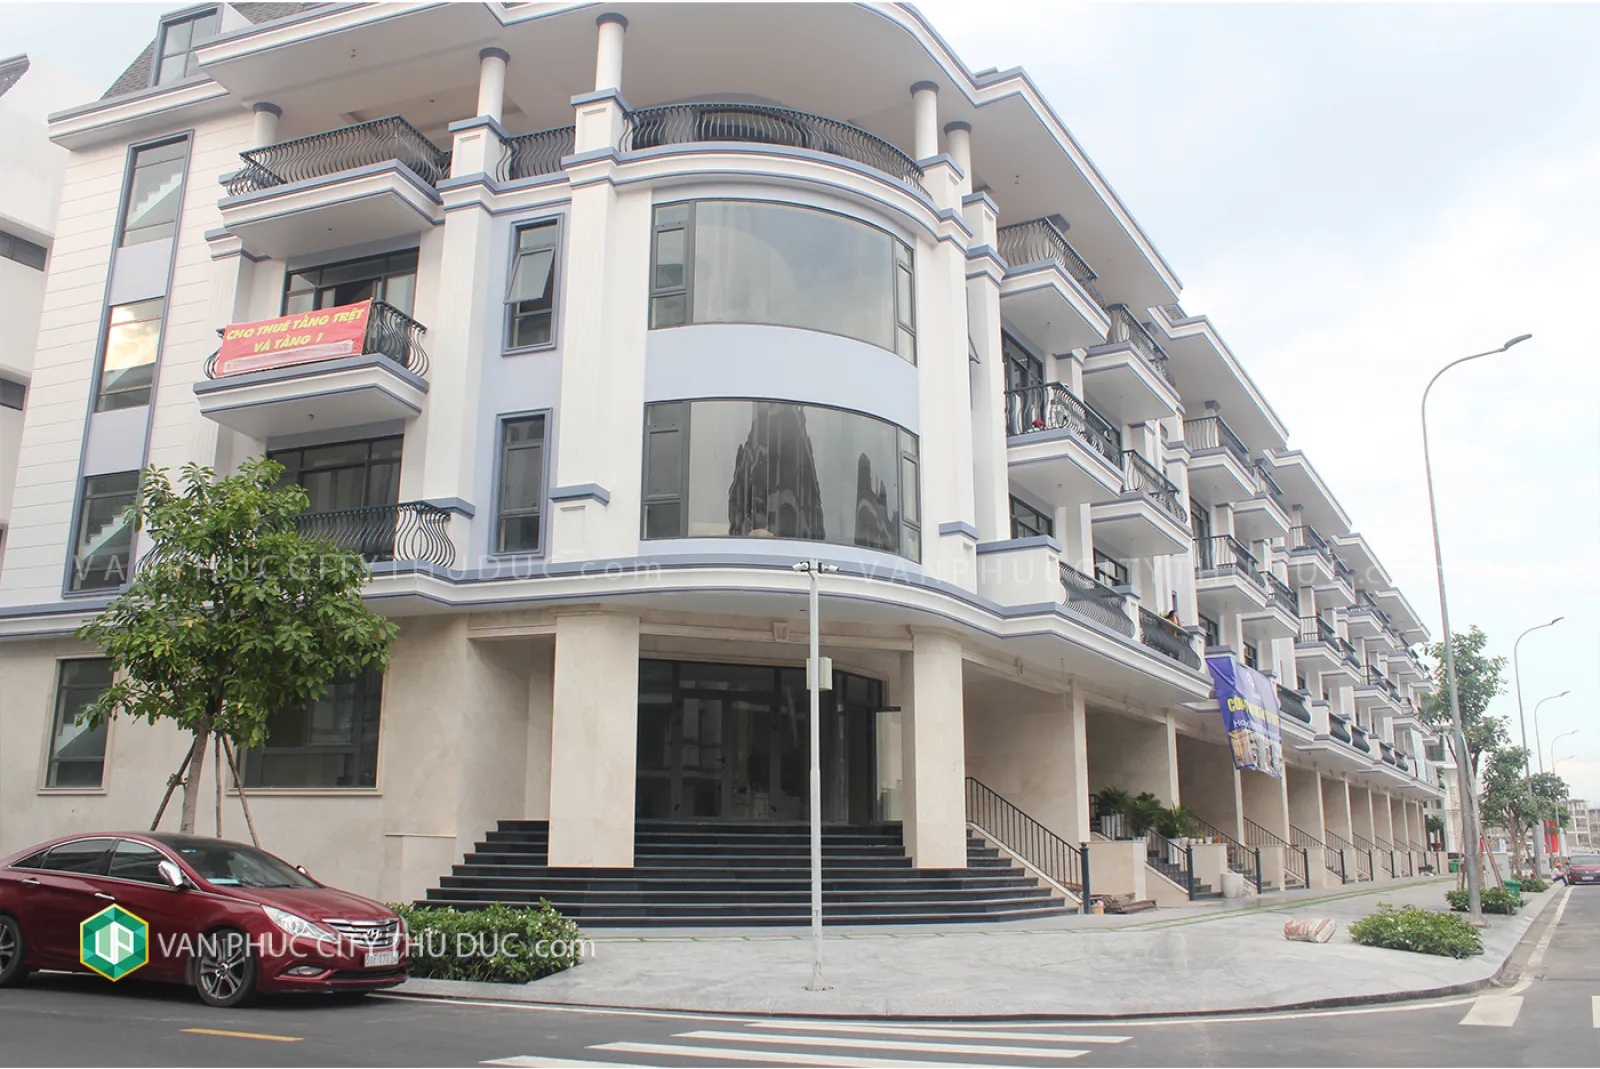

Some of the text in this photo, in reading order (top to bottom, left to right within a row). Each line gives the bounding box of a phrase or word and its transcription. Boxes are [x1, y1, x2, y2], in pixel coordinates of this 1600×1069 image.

[226, 328, 254, 341] CHO
[256, 319, 291, 336] THUÊ
[332, 307, 366, 324] TRỆT
[254, 339, 271, 353] VÀ
[316, 332, 324, 343] 1
